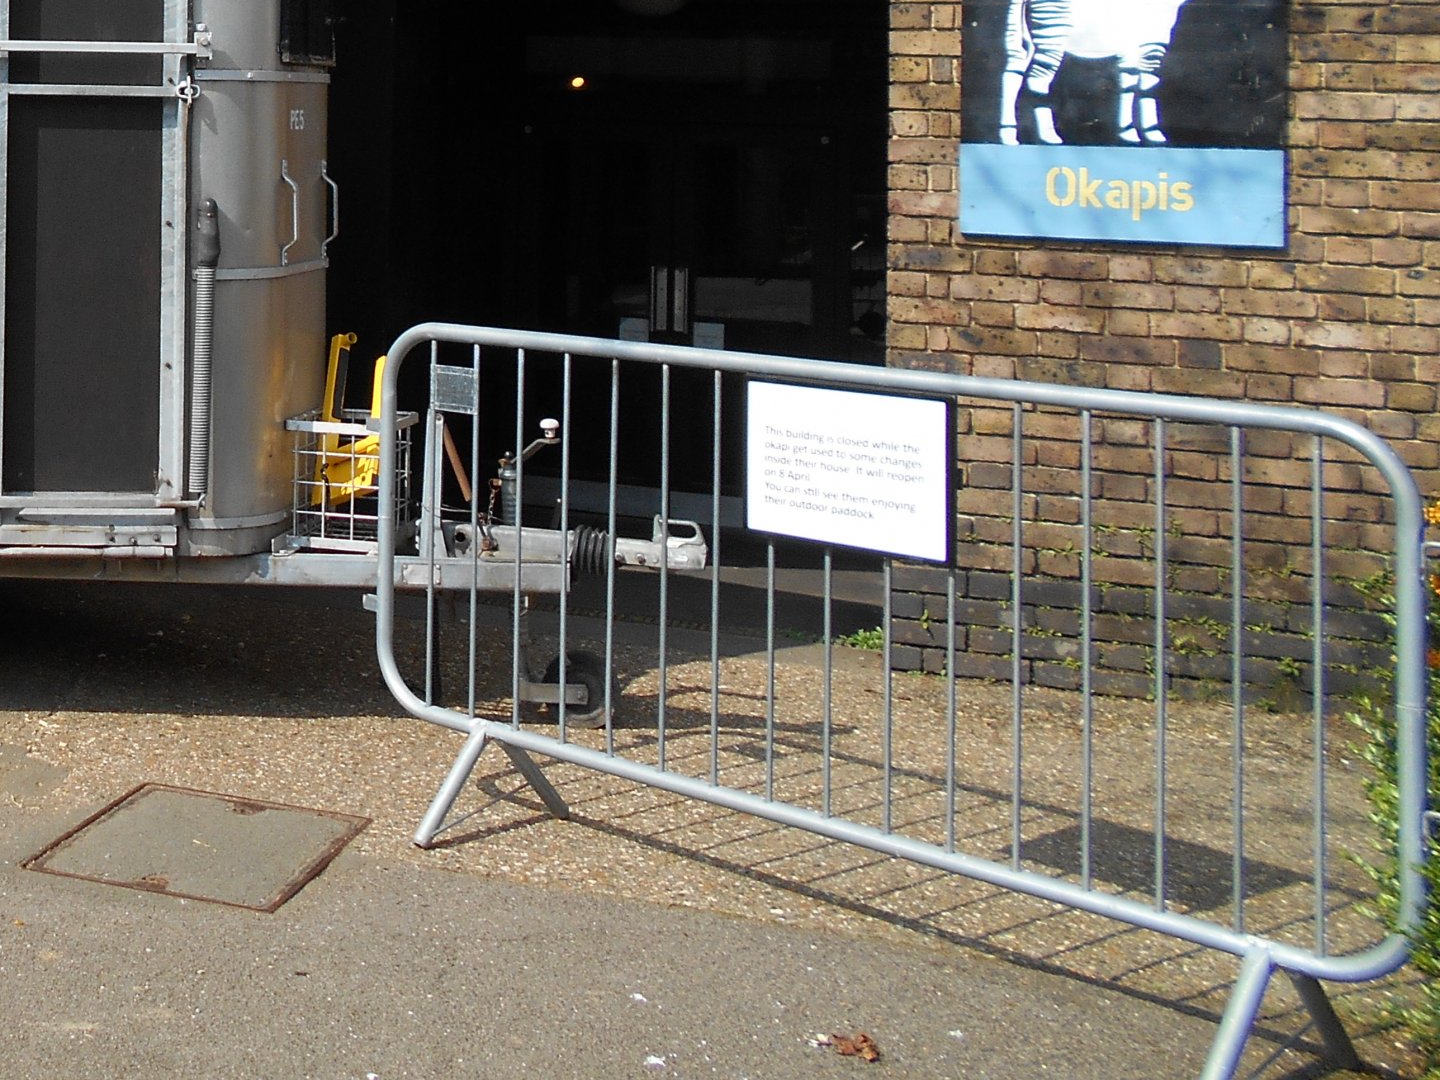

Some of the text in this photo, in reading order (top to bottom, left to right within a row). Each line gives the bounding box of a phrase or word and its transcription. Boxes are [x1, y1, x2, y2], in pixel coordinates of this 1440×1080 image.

[1045, 166, 1194, 222] Okapis
[765, 425, 783, 436] This
[786, 429, 824, 444] building
[837, 437, 869, 447] closed
[872, 442, 900, 451] while
[903, 444, 920, 454] the
[765, 441, 922, 470] okapi get used to some changes
[765, 455, 791, 465] inside
[795, 459, 816, 468] their
[856, 466, 863, 474] It
[866, 469, 884, 477] will
[887, 471, 924, 483] reopen
[765, 482, 916, 513] You can still see them enjoying
[765, 495, 786, 505] their
[789, 499, 827, 512] outdoor
